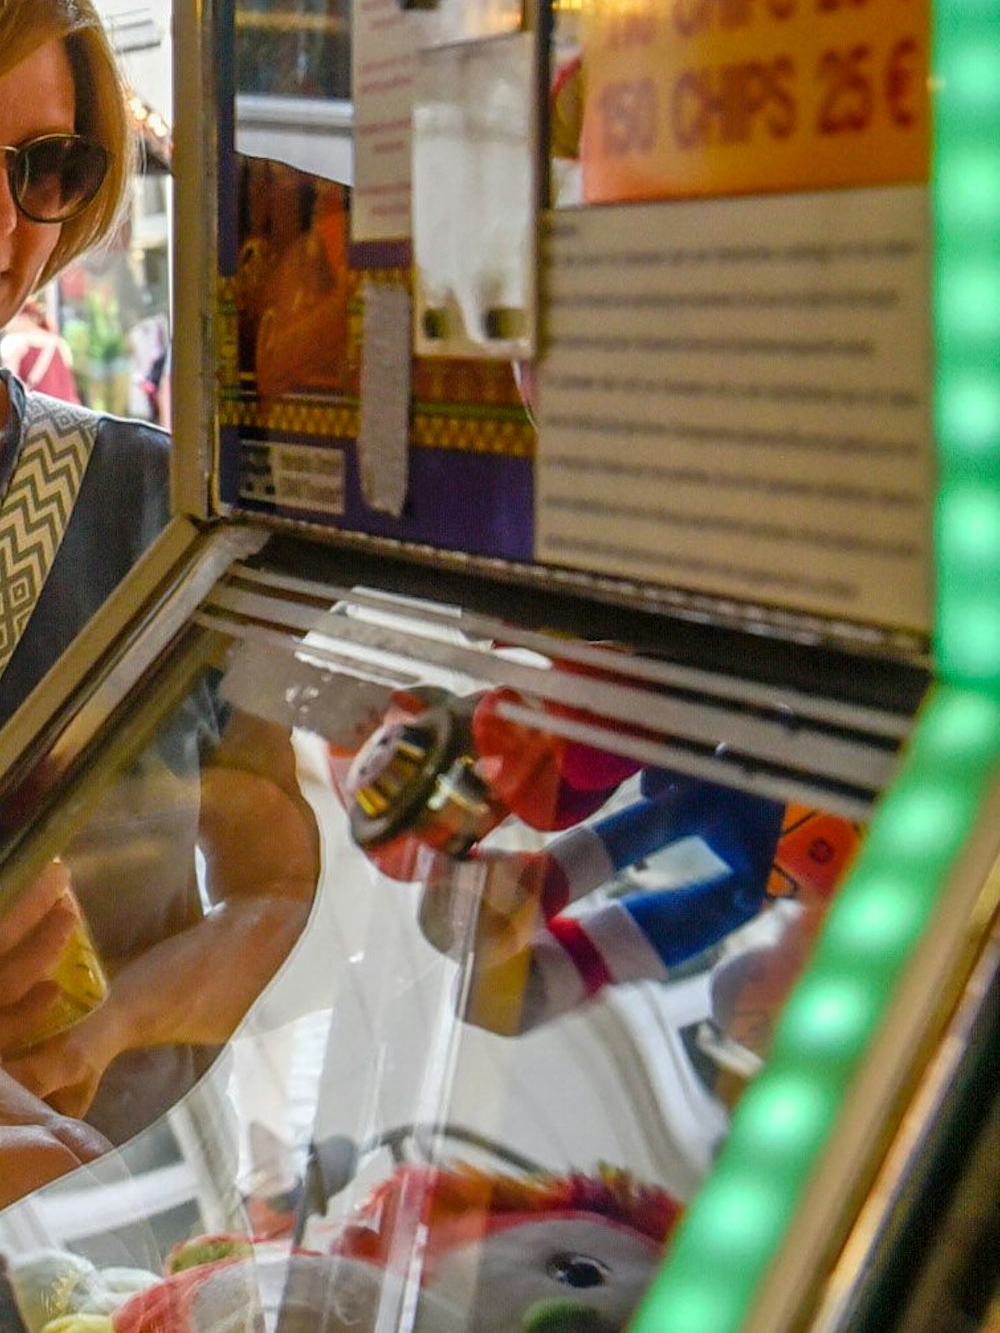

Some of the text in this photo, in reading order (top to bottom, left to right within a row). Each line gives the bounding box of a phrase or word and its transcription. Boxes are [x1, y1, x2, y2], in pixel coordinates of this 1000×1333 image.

[670, 53, 797, 151] CHIPS
[814, 41, 875, 139] 25
[884, 34, 918, 131] €
